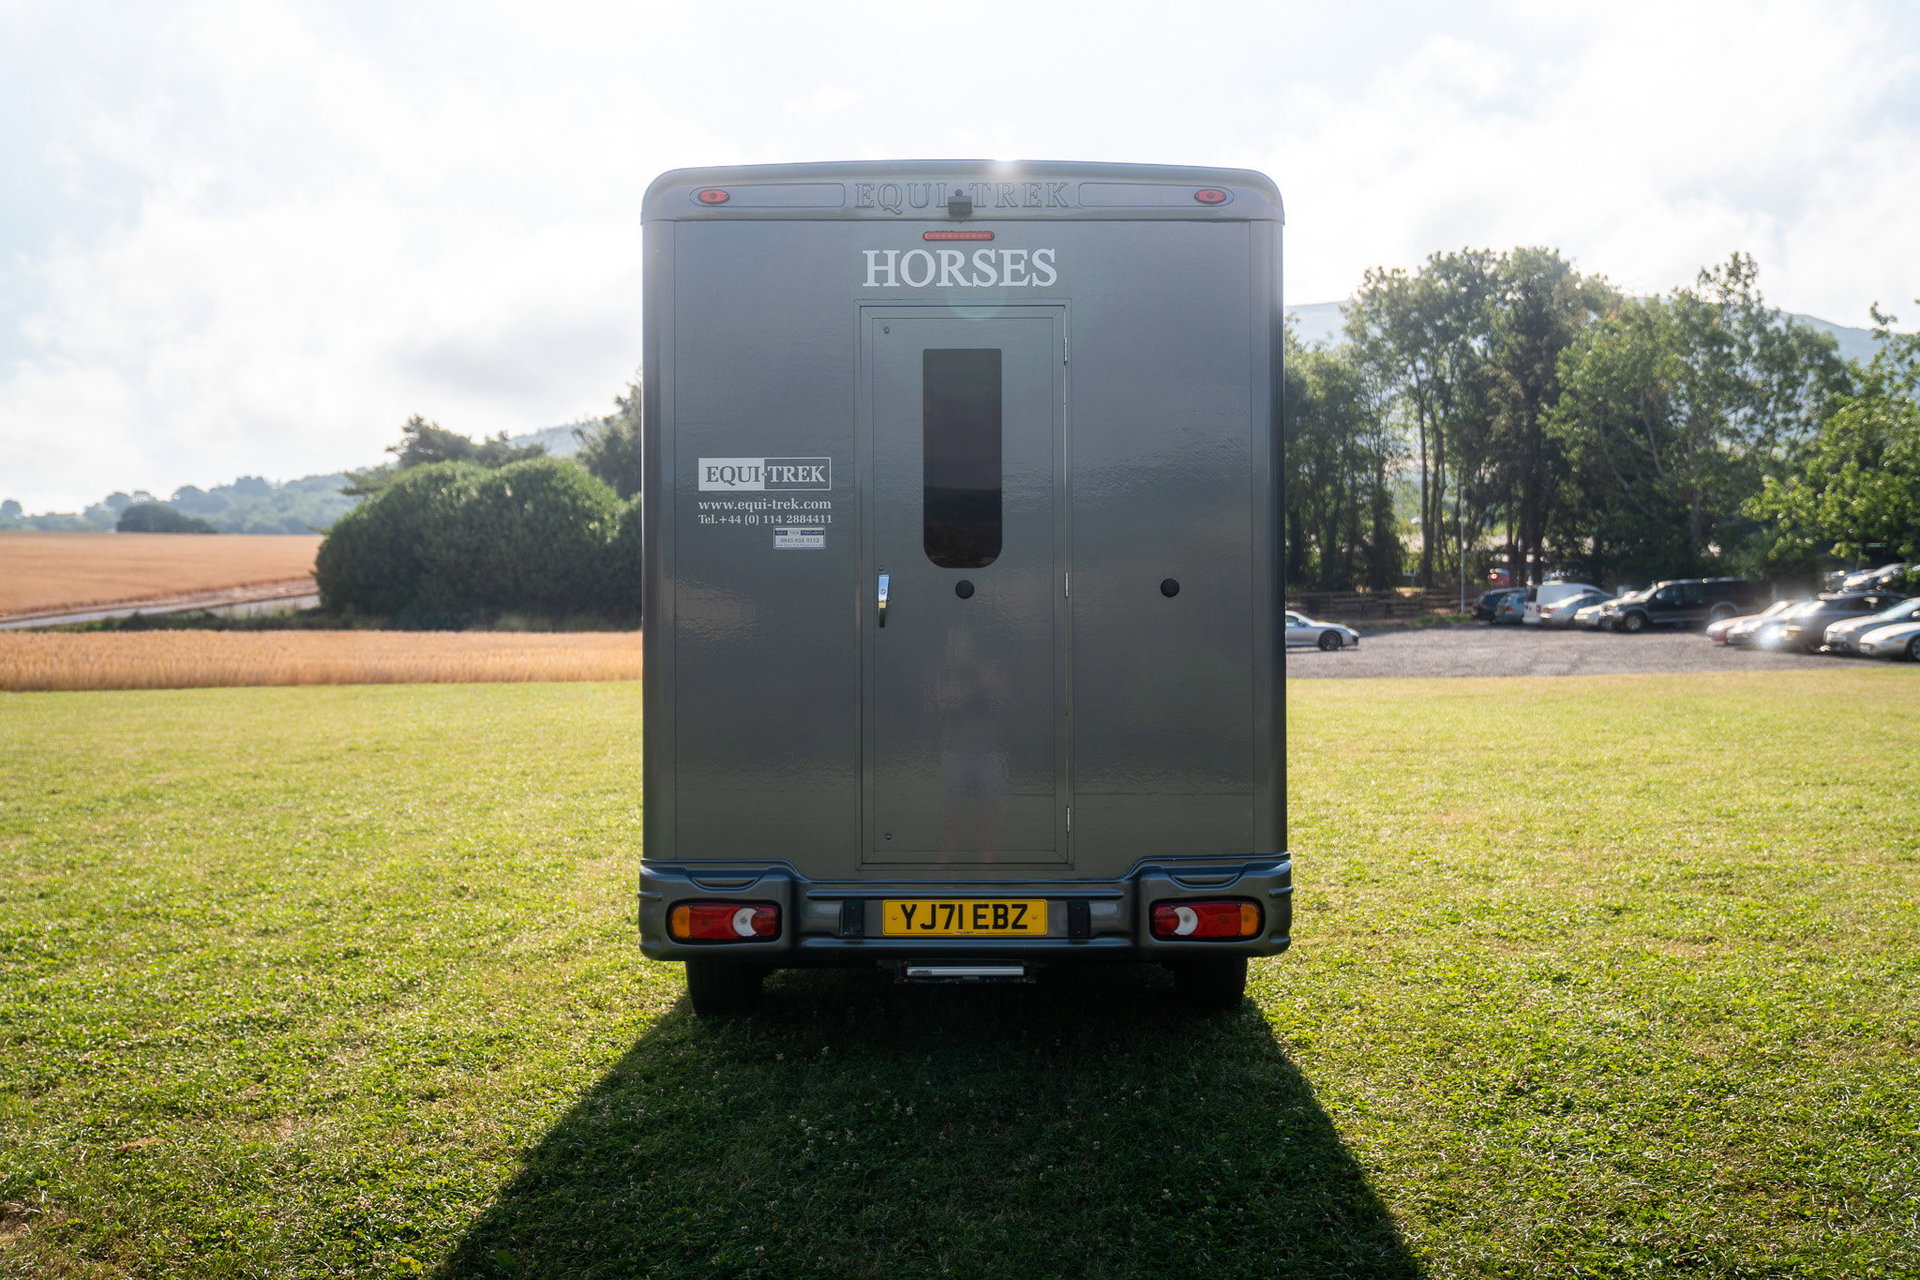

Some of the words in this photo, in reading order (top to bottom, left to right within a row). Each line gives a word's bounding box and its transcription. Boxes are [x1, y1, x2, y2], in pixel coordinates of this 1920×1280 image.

[855, 182, 948, 216] EQUI
[969, 182, 1070, 208] TREK
[862, 248, 1058, 288] HORSES
[767, 465, 826, 482] TREK
[698, 497, 832, 513] www.equi-trek.com
[744, 514, 760, 526] (0)
[763, 514, 782, 524] 114
[786, 514, 832, 524] 2884411
[900, 903, 964, 930] YJ71
[973, 903, 1028, 930] EBZ
